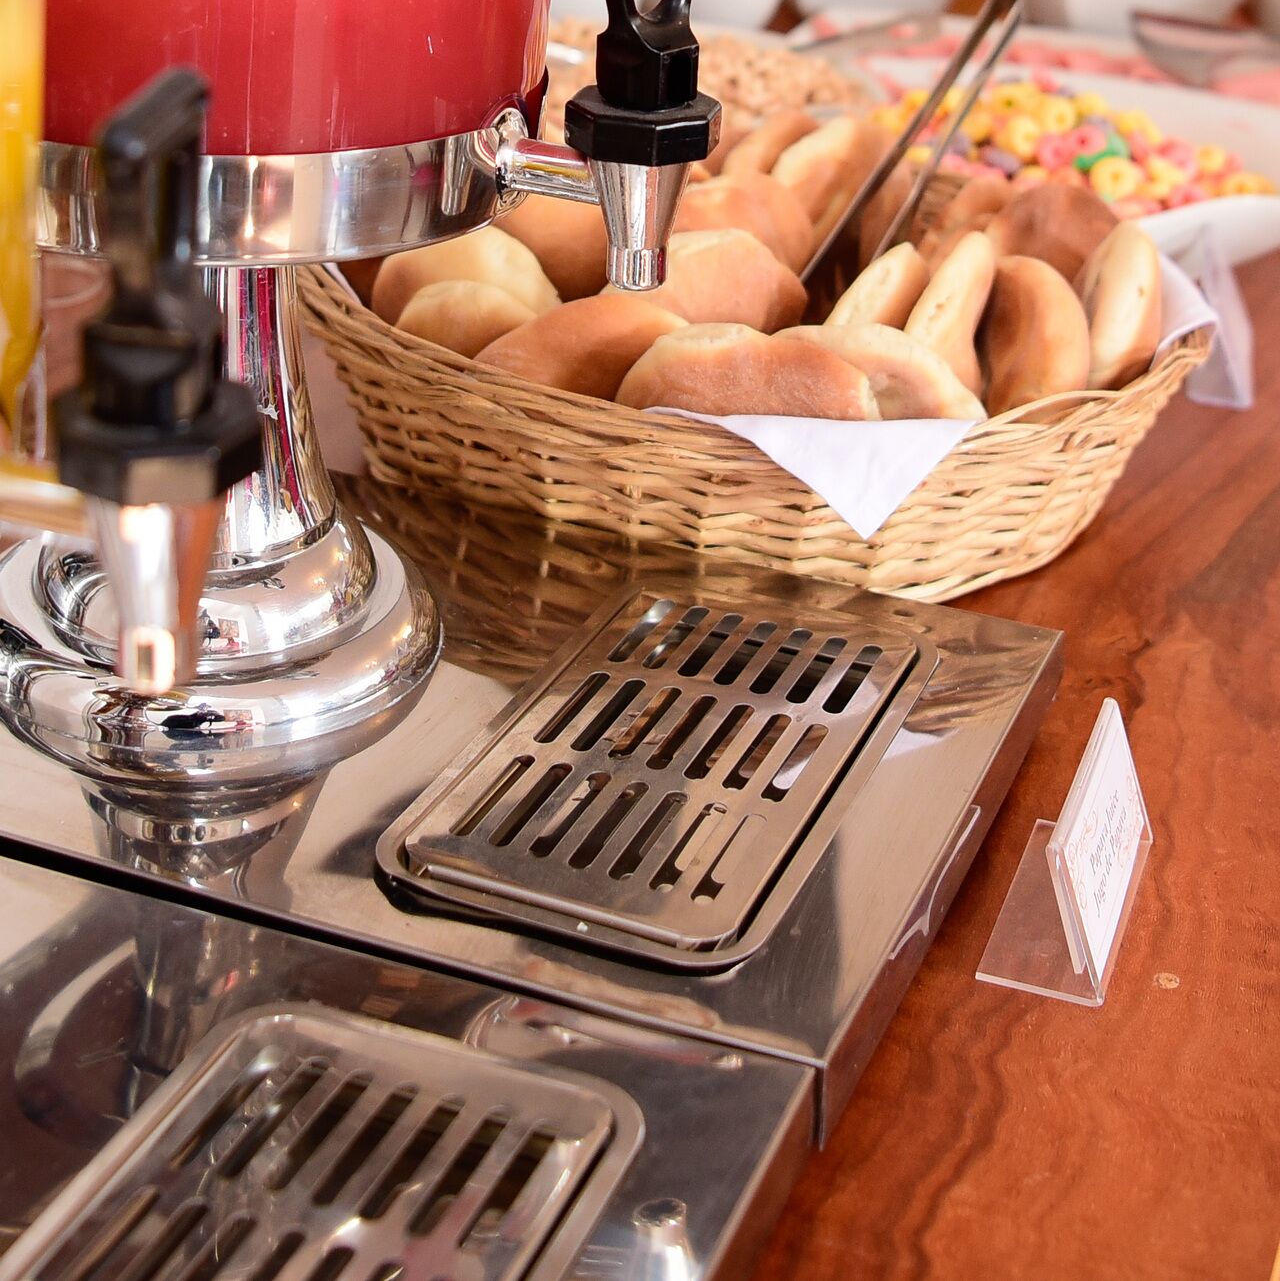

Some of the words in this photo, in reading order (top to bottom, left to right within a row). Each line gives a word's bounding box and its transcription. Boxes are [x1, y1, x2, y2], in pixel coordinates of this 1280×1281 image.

[1089, 823, 1108, 876] Papaya
[1105, 789, 1119, 834] Juice
[1093, 872, 1107, 918] Jugo
[1109, 806, 1127, 857] Papaya
